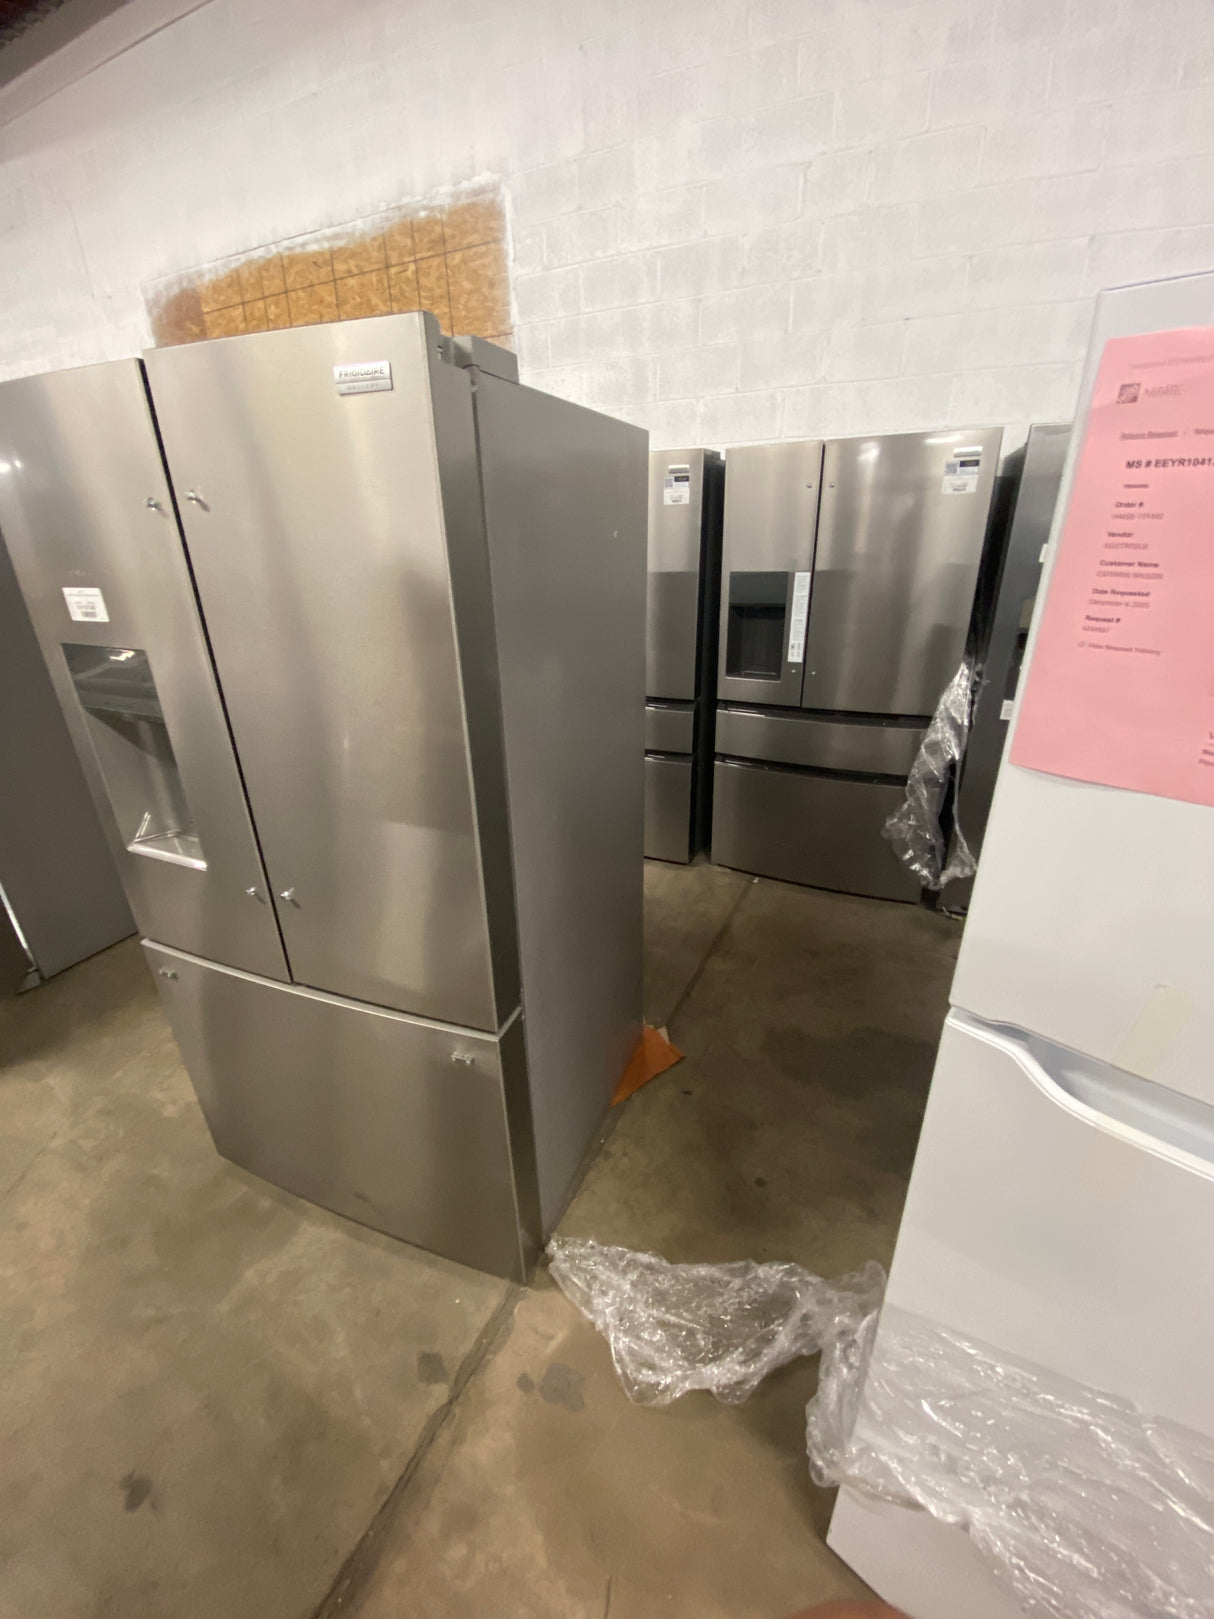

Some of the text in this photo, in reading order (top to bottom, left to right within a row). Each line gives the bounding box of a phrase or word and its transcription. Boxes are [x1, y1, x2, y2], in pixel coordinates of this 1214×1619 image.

[338, 366, 385, 378] FRIGIDAIRE
[1126, 459, 1142, 469] MS
[1154, 457, 1214, 468] EEYR1041
[1099, 559, 1135, 567] Customer
[1110, 589, 1150, 597] Requested
[1085, 615, 1114, 623] Request
